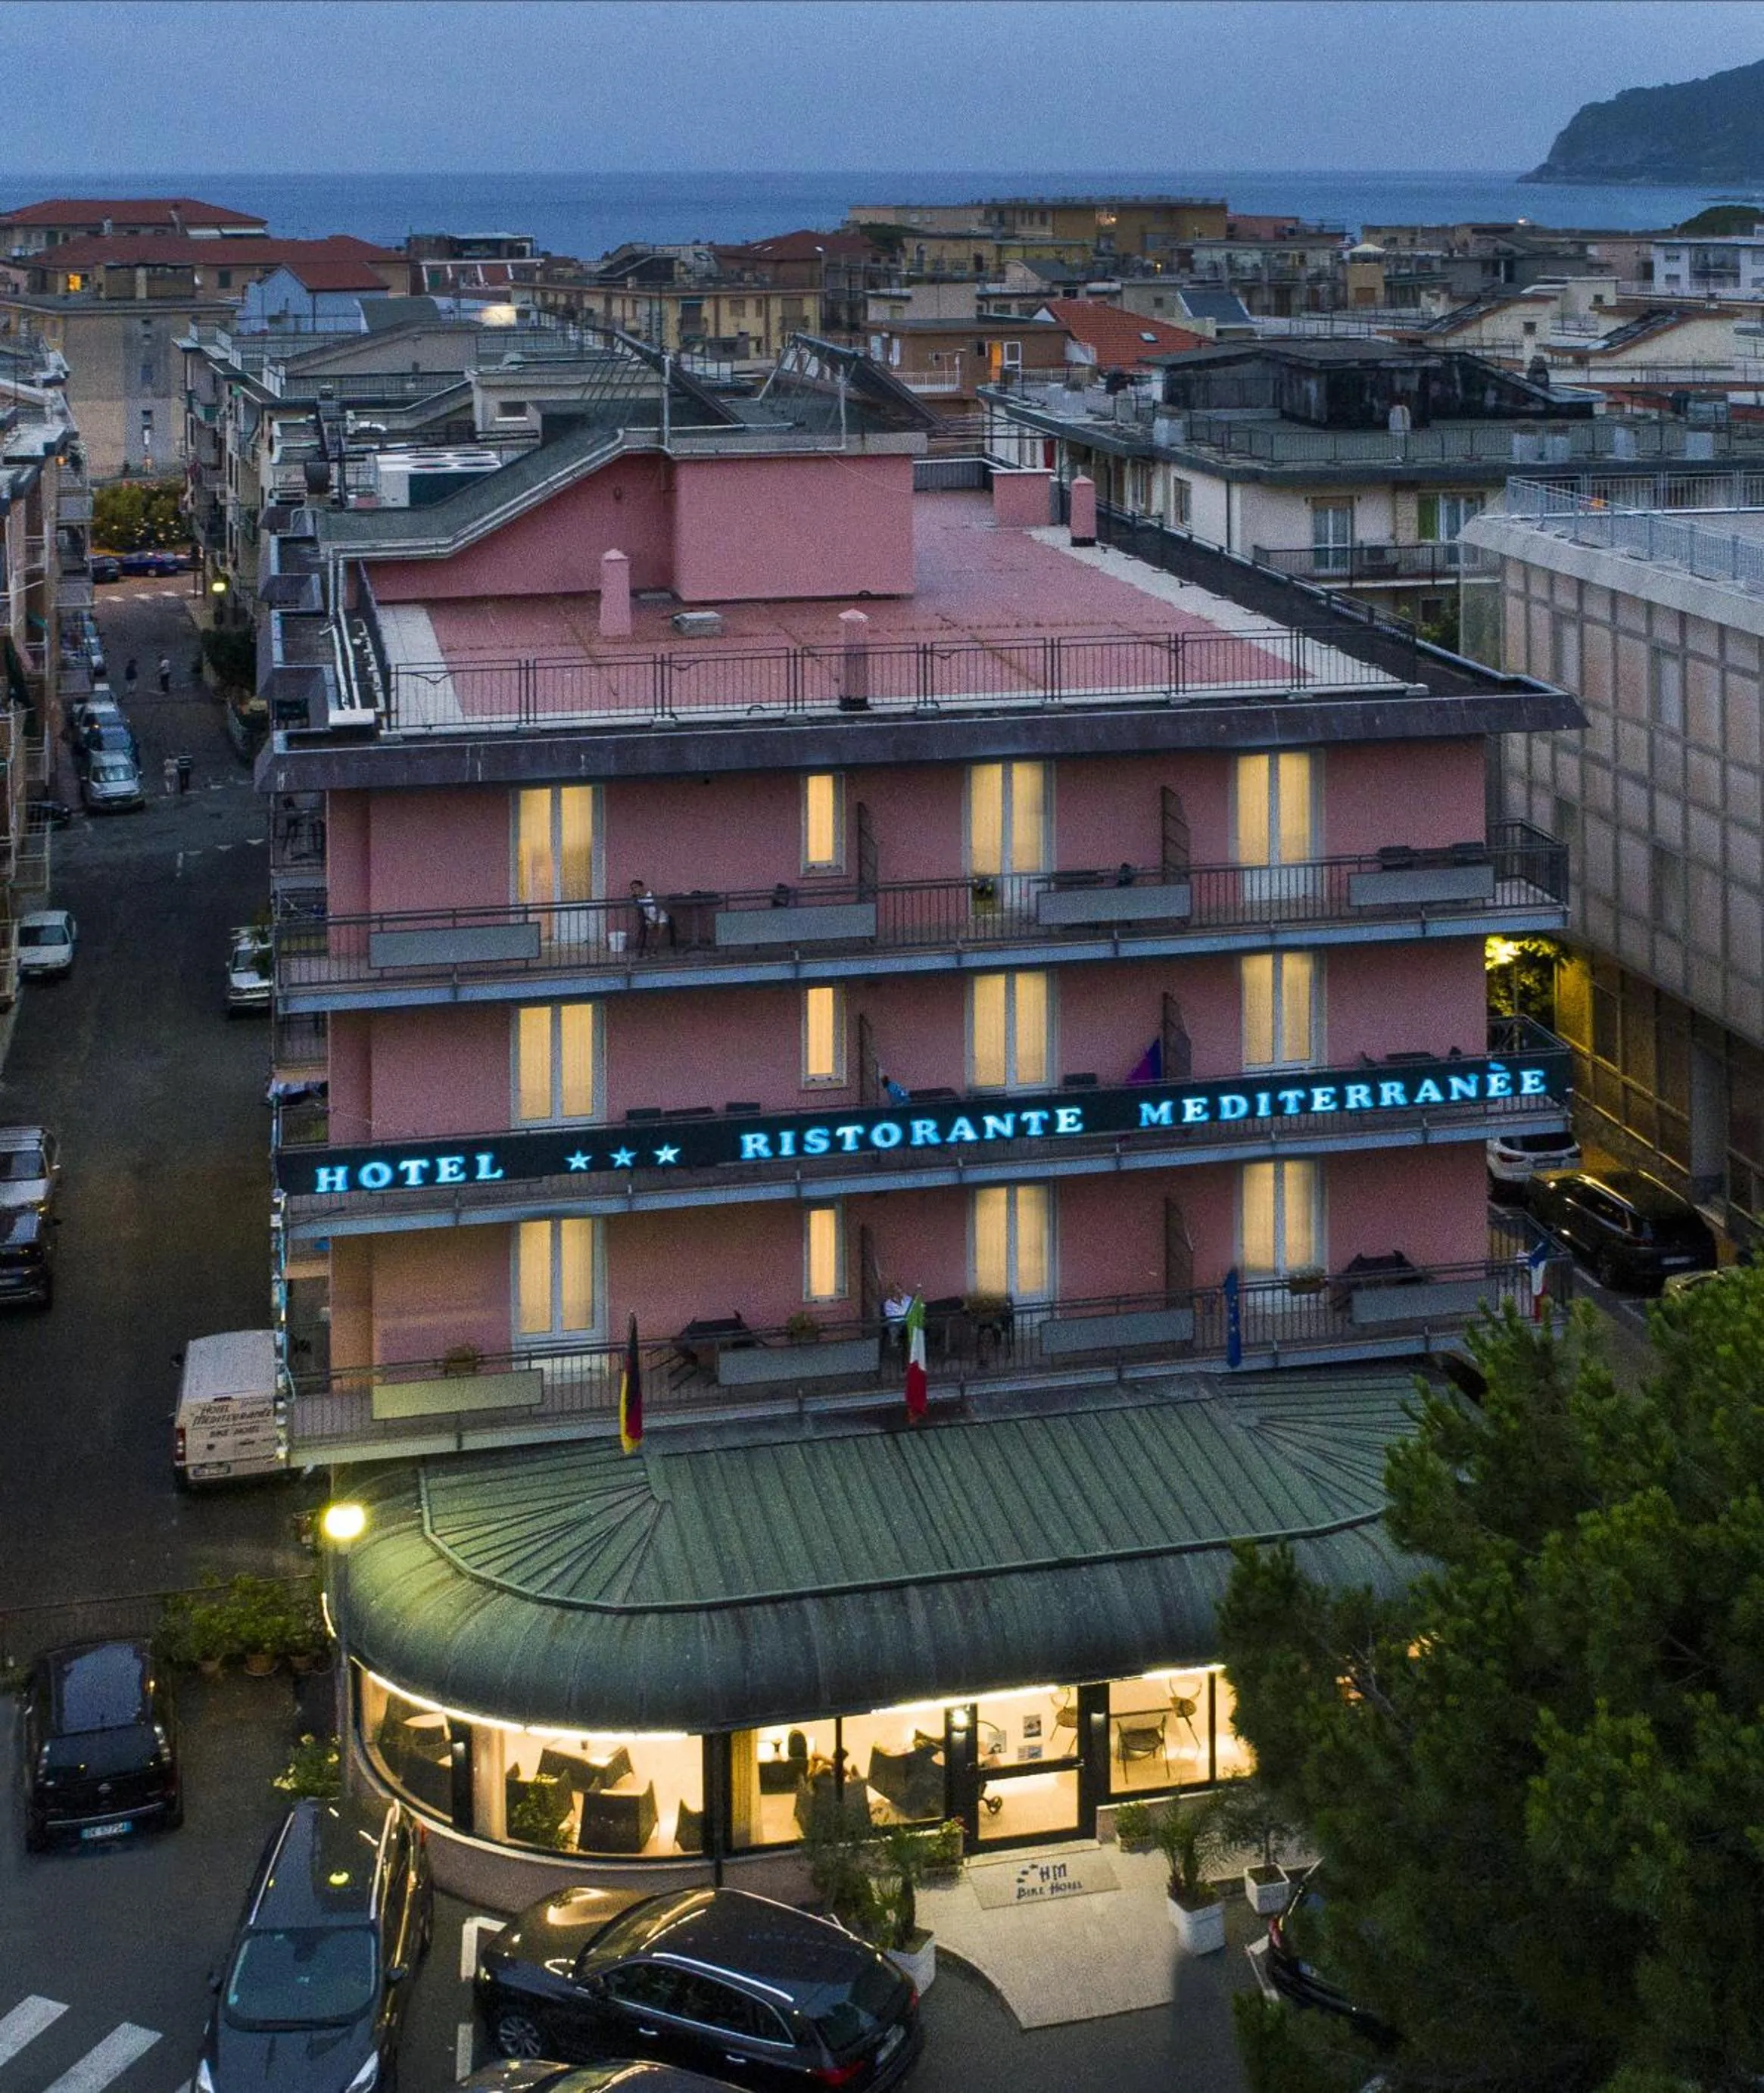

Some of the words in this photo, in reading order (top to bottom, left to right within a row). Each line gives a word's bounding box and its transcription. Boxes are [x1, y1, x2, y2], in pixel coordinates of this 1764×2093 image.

[314, 1153, 504, 1194] HOTEL
[740, 1107, 1084, 1160] RISTORANTE
[1138, 1061, 1547, 1128] MEDITERRANÈE
